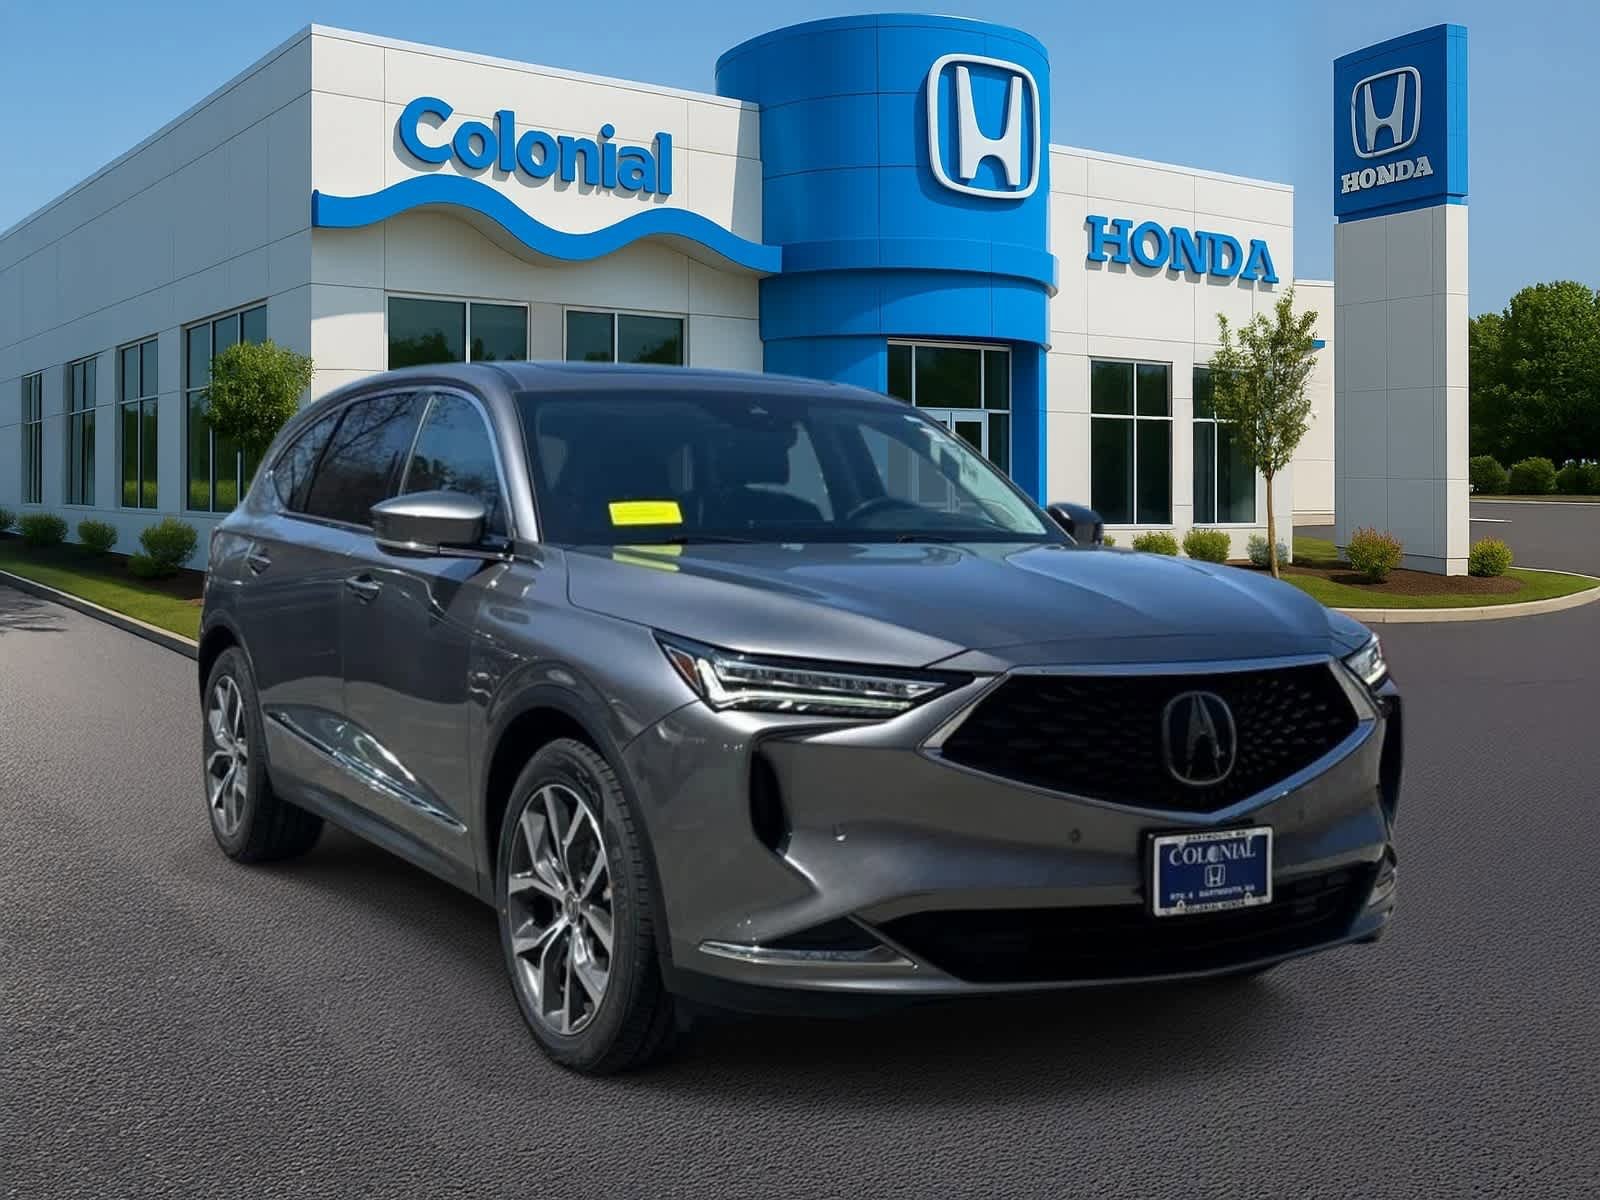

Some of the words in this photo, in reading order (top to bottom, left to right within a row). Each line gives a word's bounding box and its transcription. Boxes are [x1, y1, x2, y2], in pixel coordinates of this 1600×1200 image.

[399, 96, 673, 195] Colonial
[1341, 155, 1434, 194] HONDA
[1086, 215, 1279, 284] HONDA
[1169, 842, 1256, 866] COLONIAL
